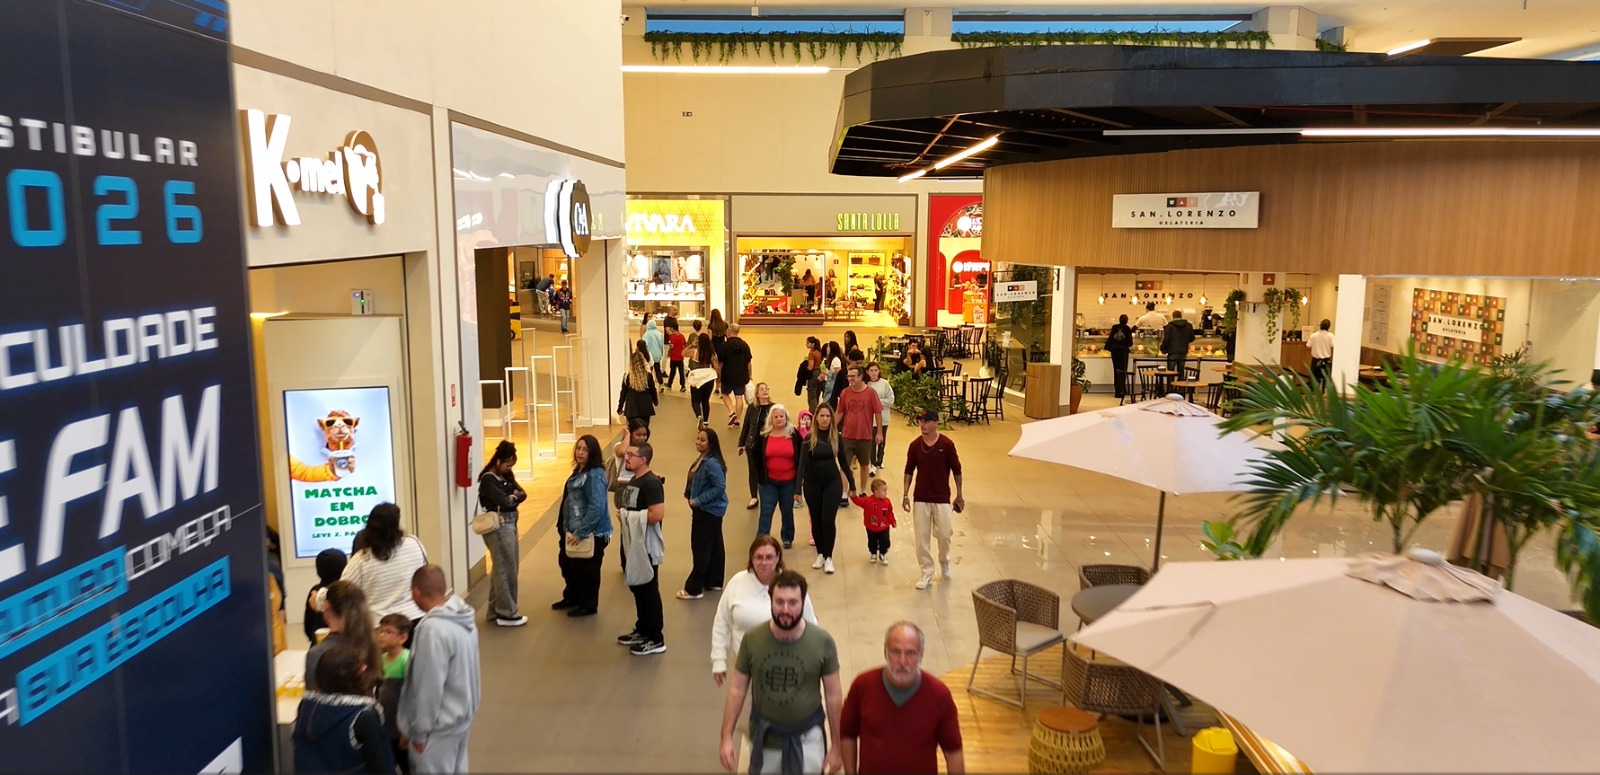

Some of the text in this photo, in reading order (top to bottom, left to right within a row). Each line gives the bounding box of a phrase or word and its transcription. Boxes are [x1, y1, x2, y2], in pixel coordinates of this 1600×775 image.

[837, 212, 900, 231] SANTA LOLLA
[37, 384, 221, 567] FAM
[305, 486, 377, 498] MATCHA
[330, 501, 354, 512] EM
[0, 504, 232, 642] UTURO COMEÇA
[28, 644, 98, 711] SUA
[106, 567, 227, 663] ESCOLHA
